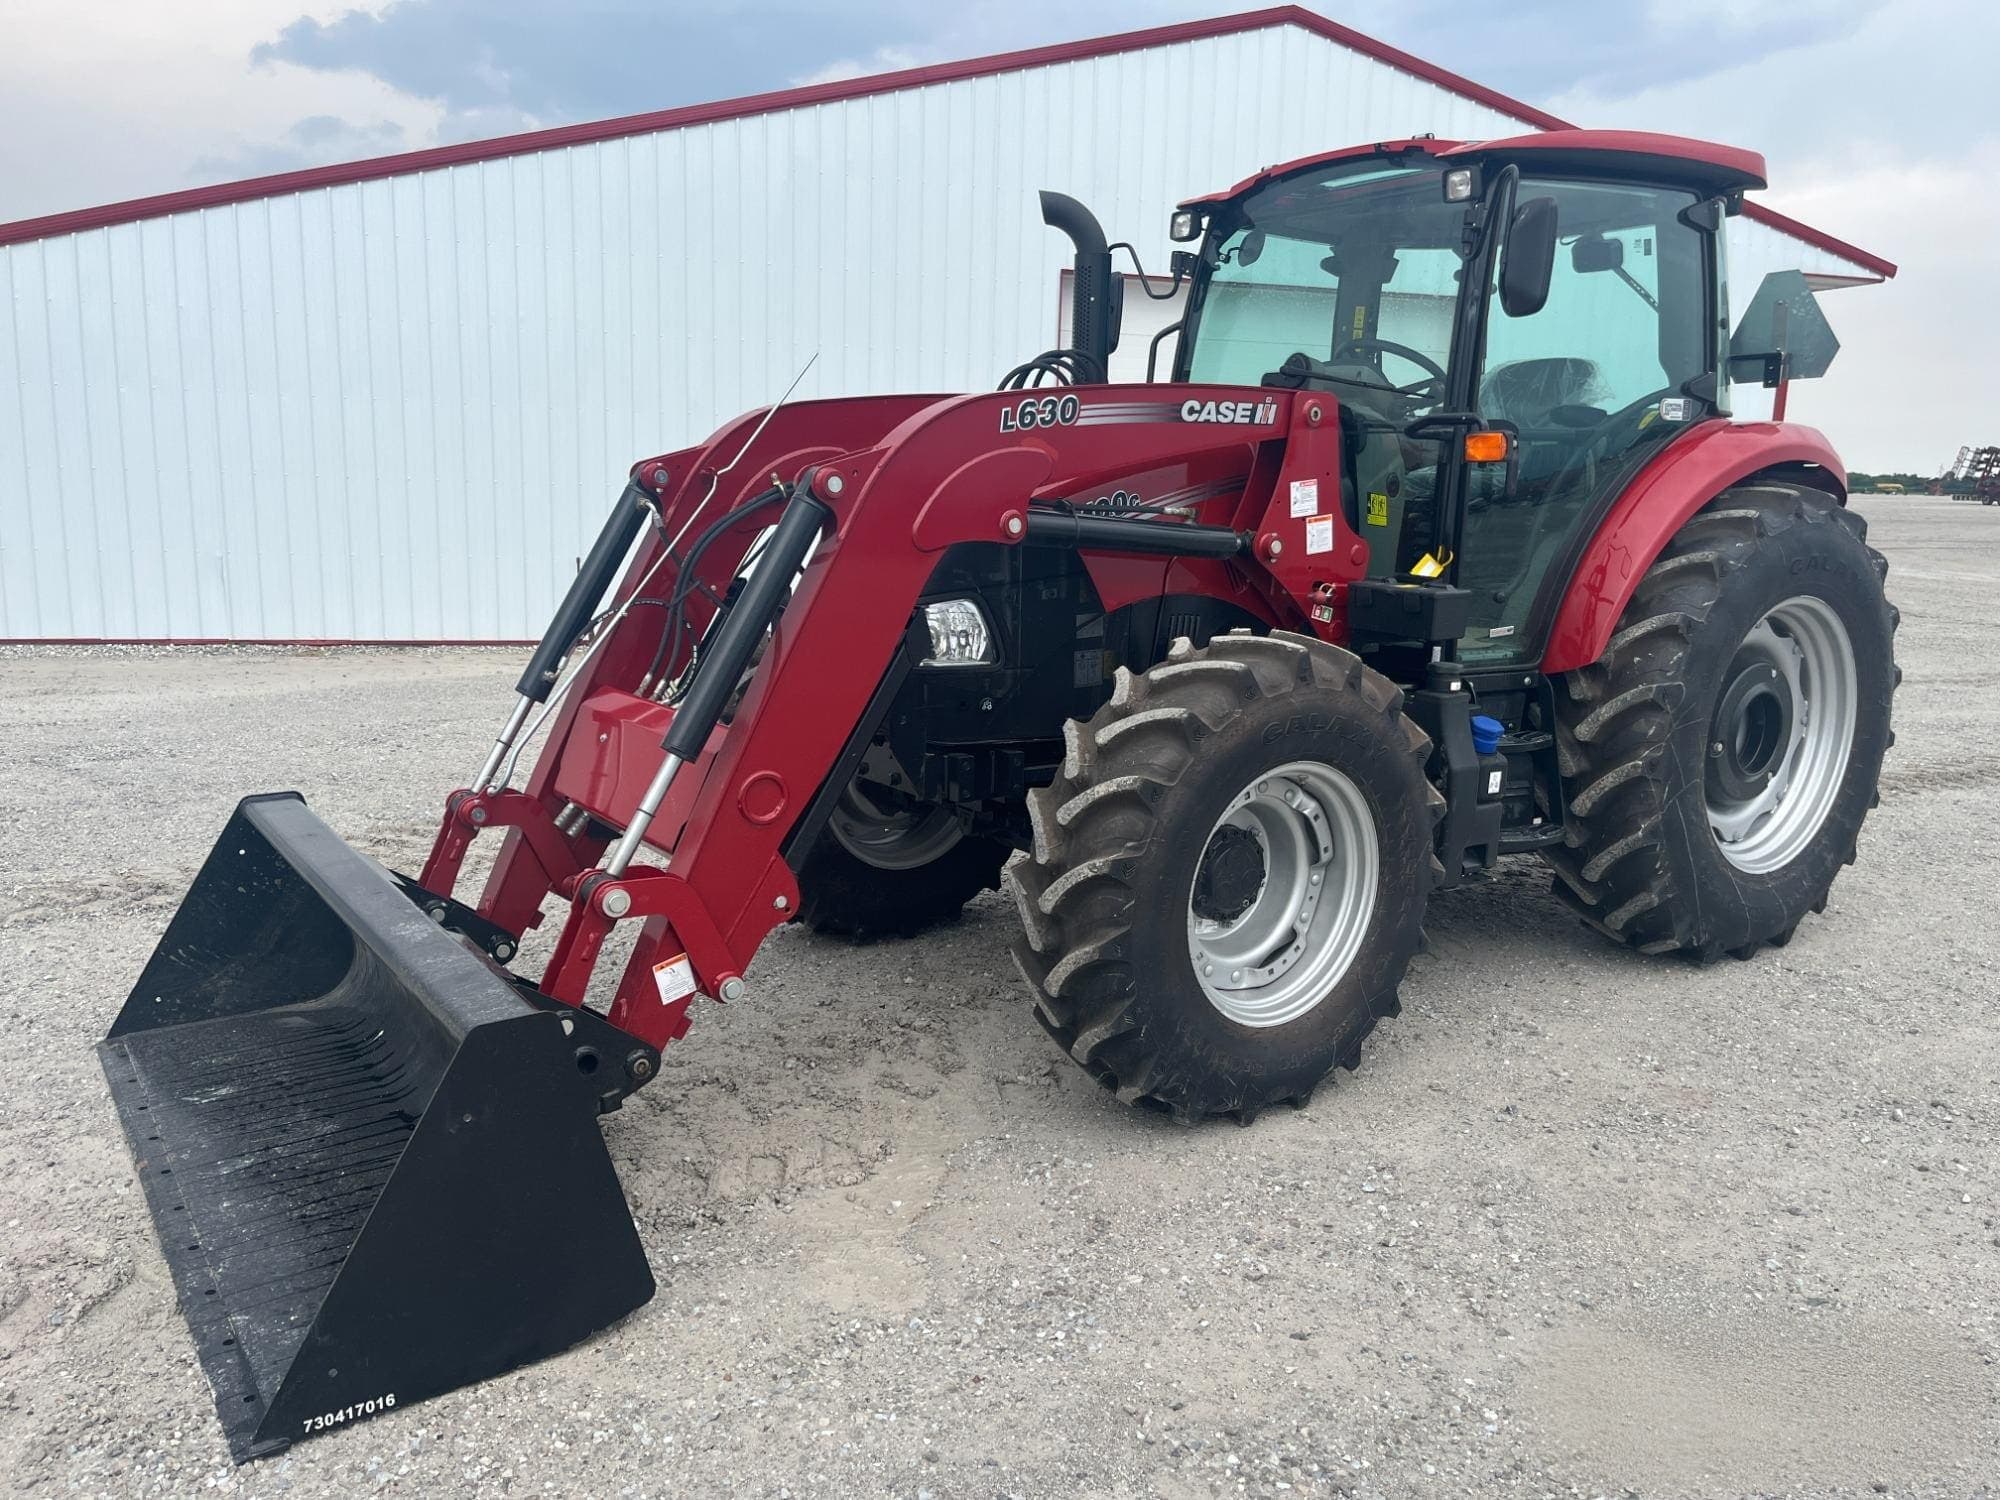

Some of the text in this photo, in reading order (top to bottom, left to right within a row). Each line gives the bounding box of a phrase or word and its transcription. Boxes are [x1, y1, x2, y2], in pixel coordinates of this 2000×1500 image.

[1000, 394, 1080, 433] L630
[1181, 400, 1253, 423] CASE
[303, 1393, 396, 1433] 730417016
